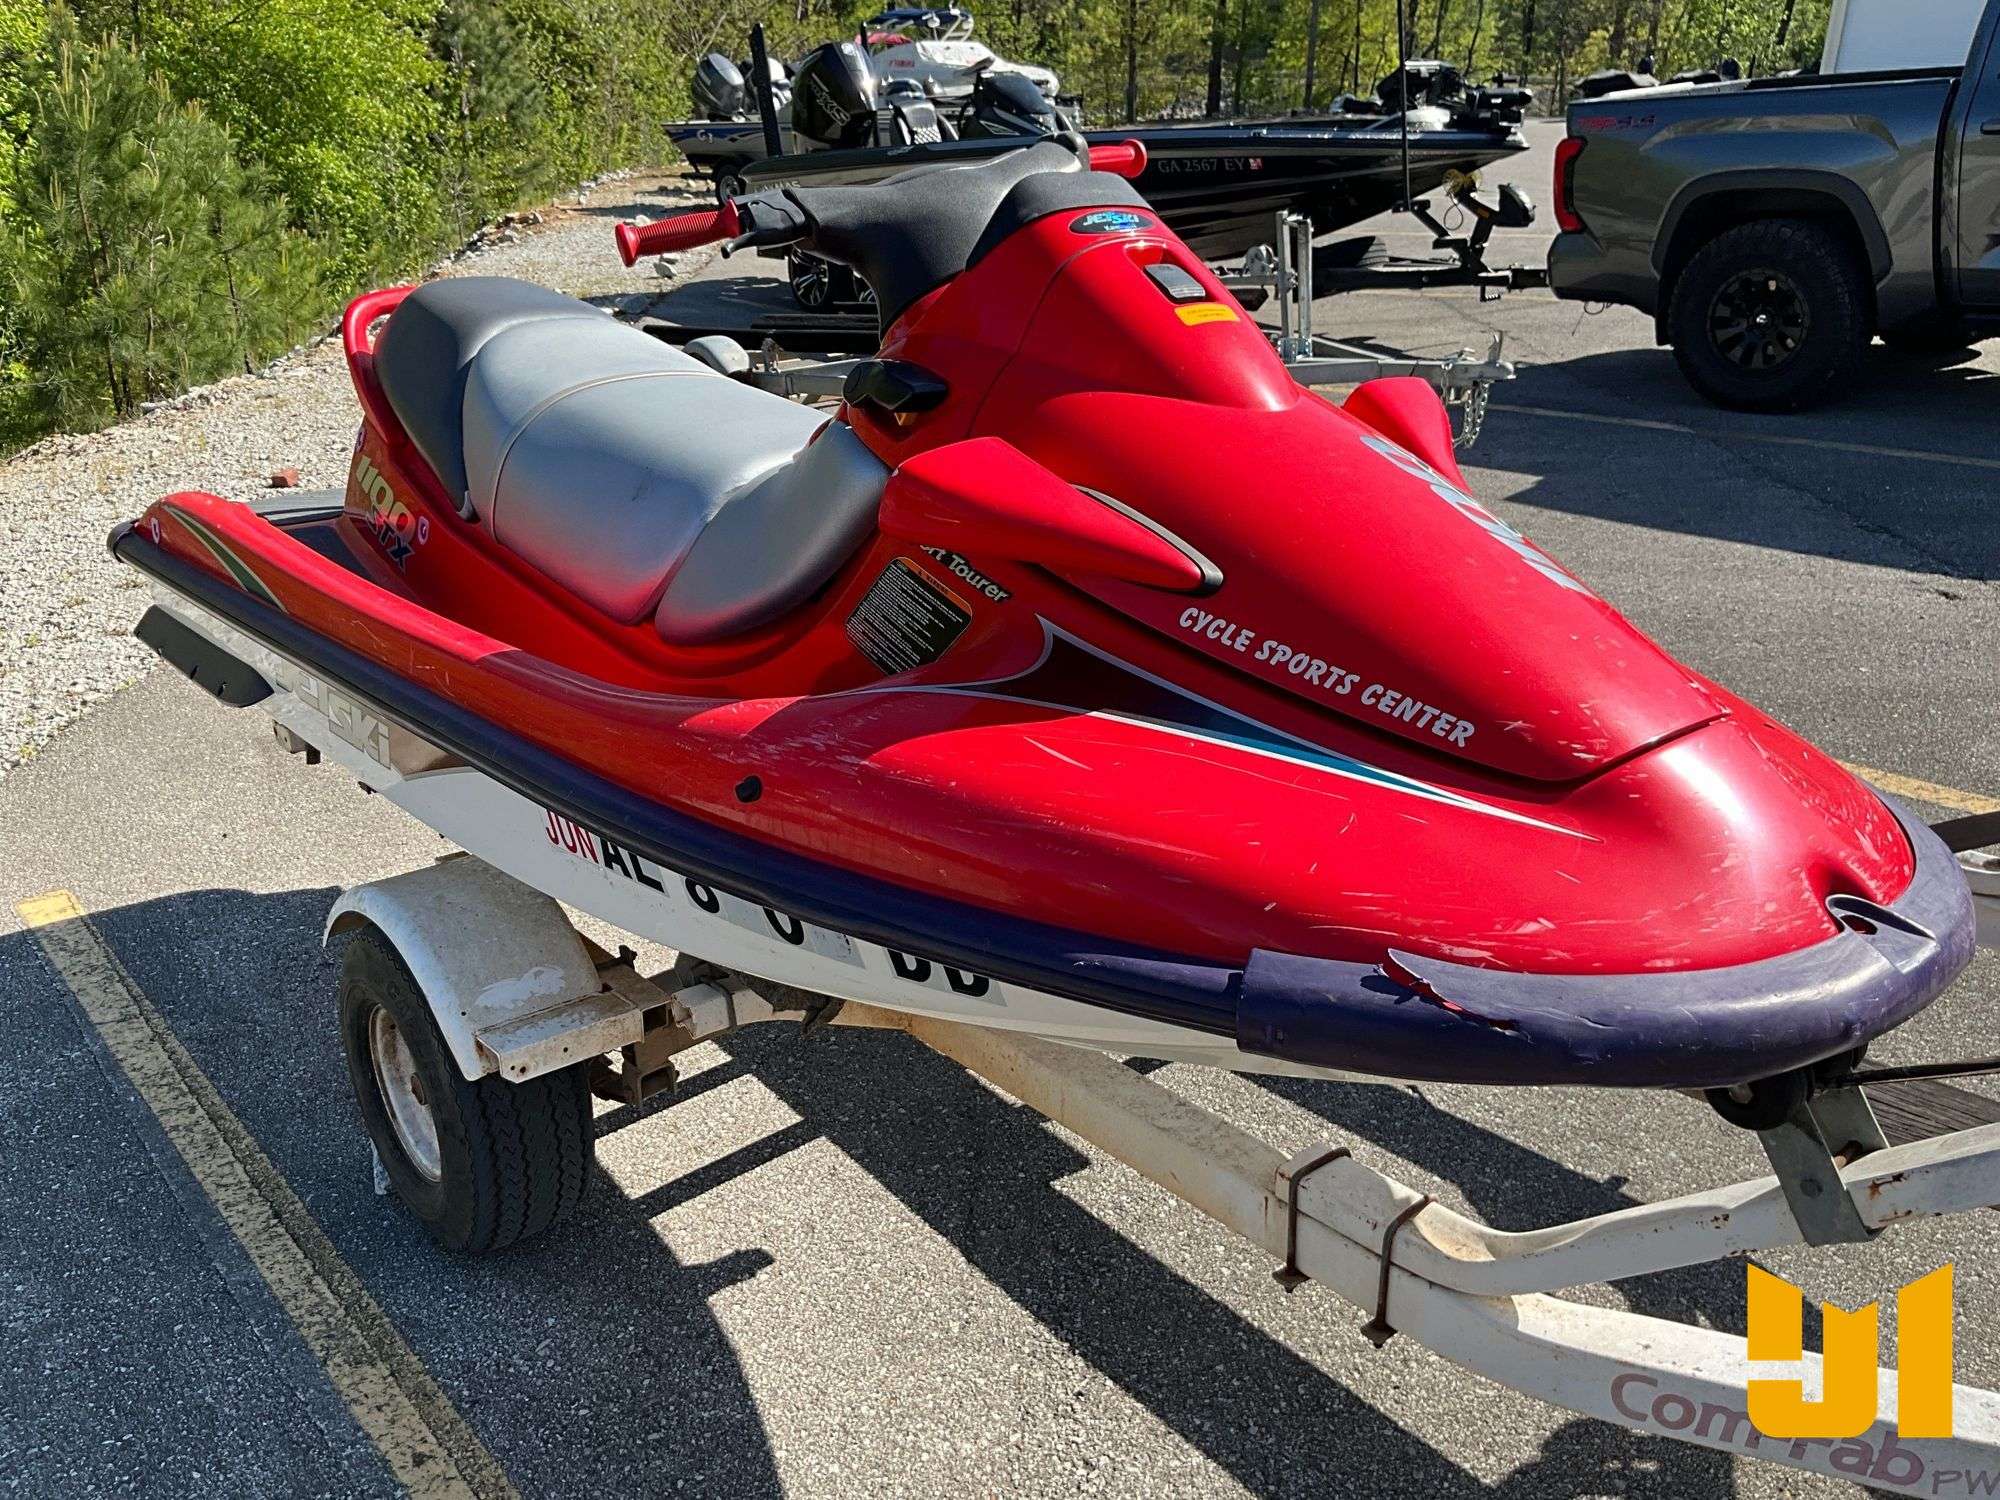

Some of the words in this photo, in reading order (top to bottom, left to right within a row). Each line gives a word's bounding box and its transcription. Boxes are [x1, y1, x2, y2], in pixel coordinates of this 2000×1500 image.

[1157, 160, 1181, 173] GA
[1184, 159, 1217, 172] 2567
[1224, 158, 1245, 170] EY
[355, 454, 416, 544] 1100
[948, 554, 1010, 601] Tourer
[1179, 607, 1255, 652] CYCLE
[1254, 640, 1360, 695] SPORTS
[1361, 684, 1475, 748] CENTER
[545, 809, 599, 864] JUN
